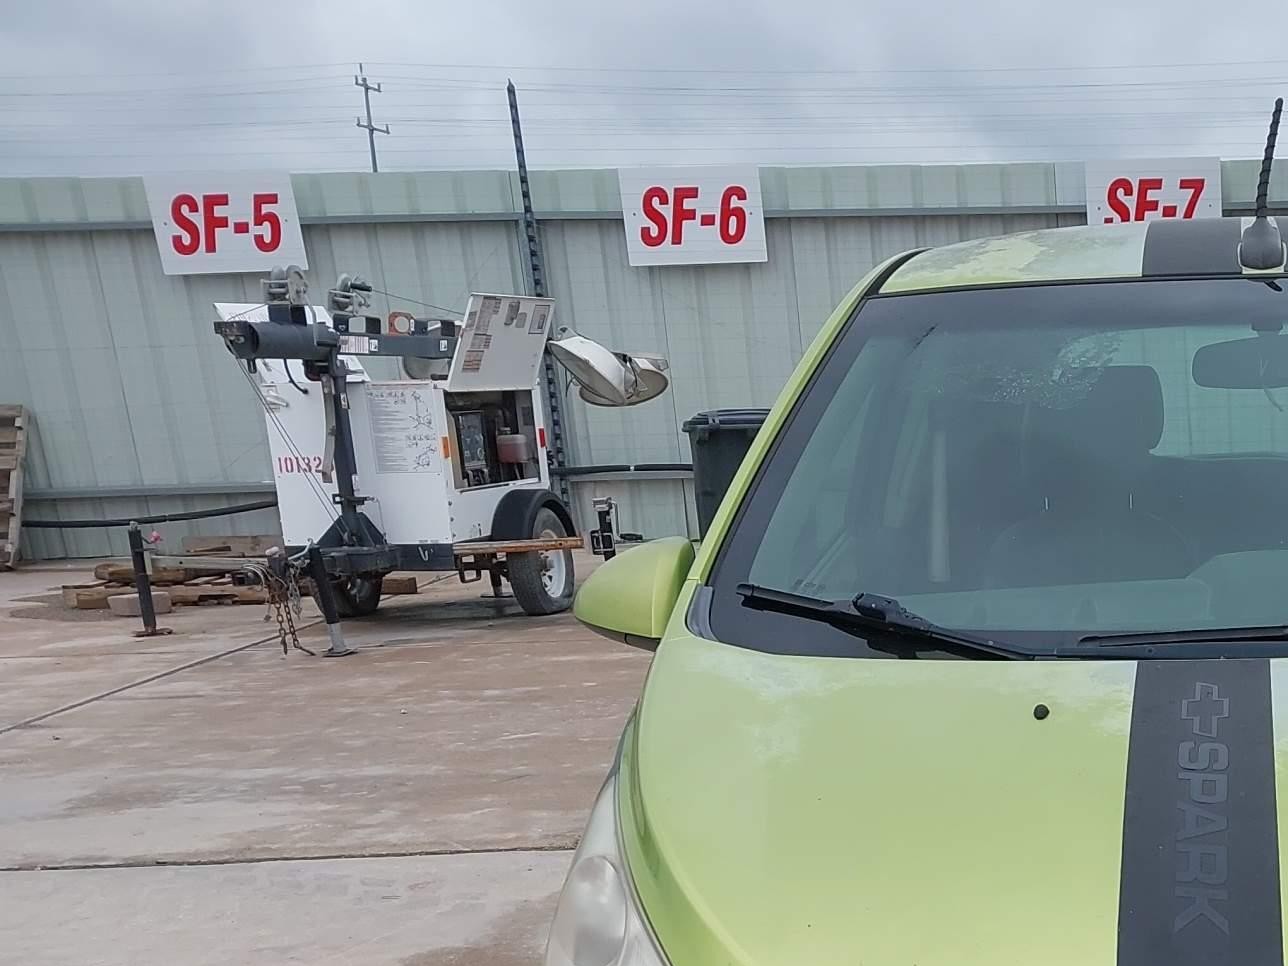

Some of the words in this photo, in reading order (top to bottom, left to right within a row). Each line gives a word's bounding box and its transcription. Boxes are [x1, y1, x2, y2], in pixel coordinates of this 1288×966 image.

[171, 193, 281, 256] SF-5
[640, 185, 748, 247] SF-6
[1104, 177, 1206, 224] SF-7
[1173, 740, 1230, 936] SPARK
